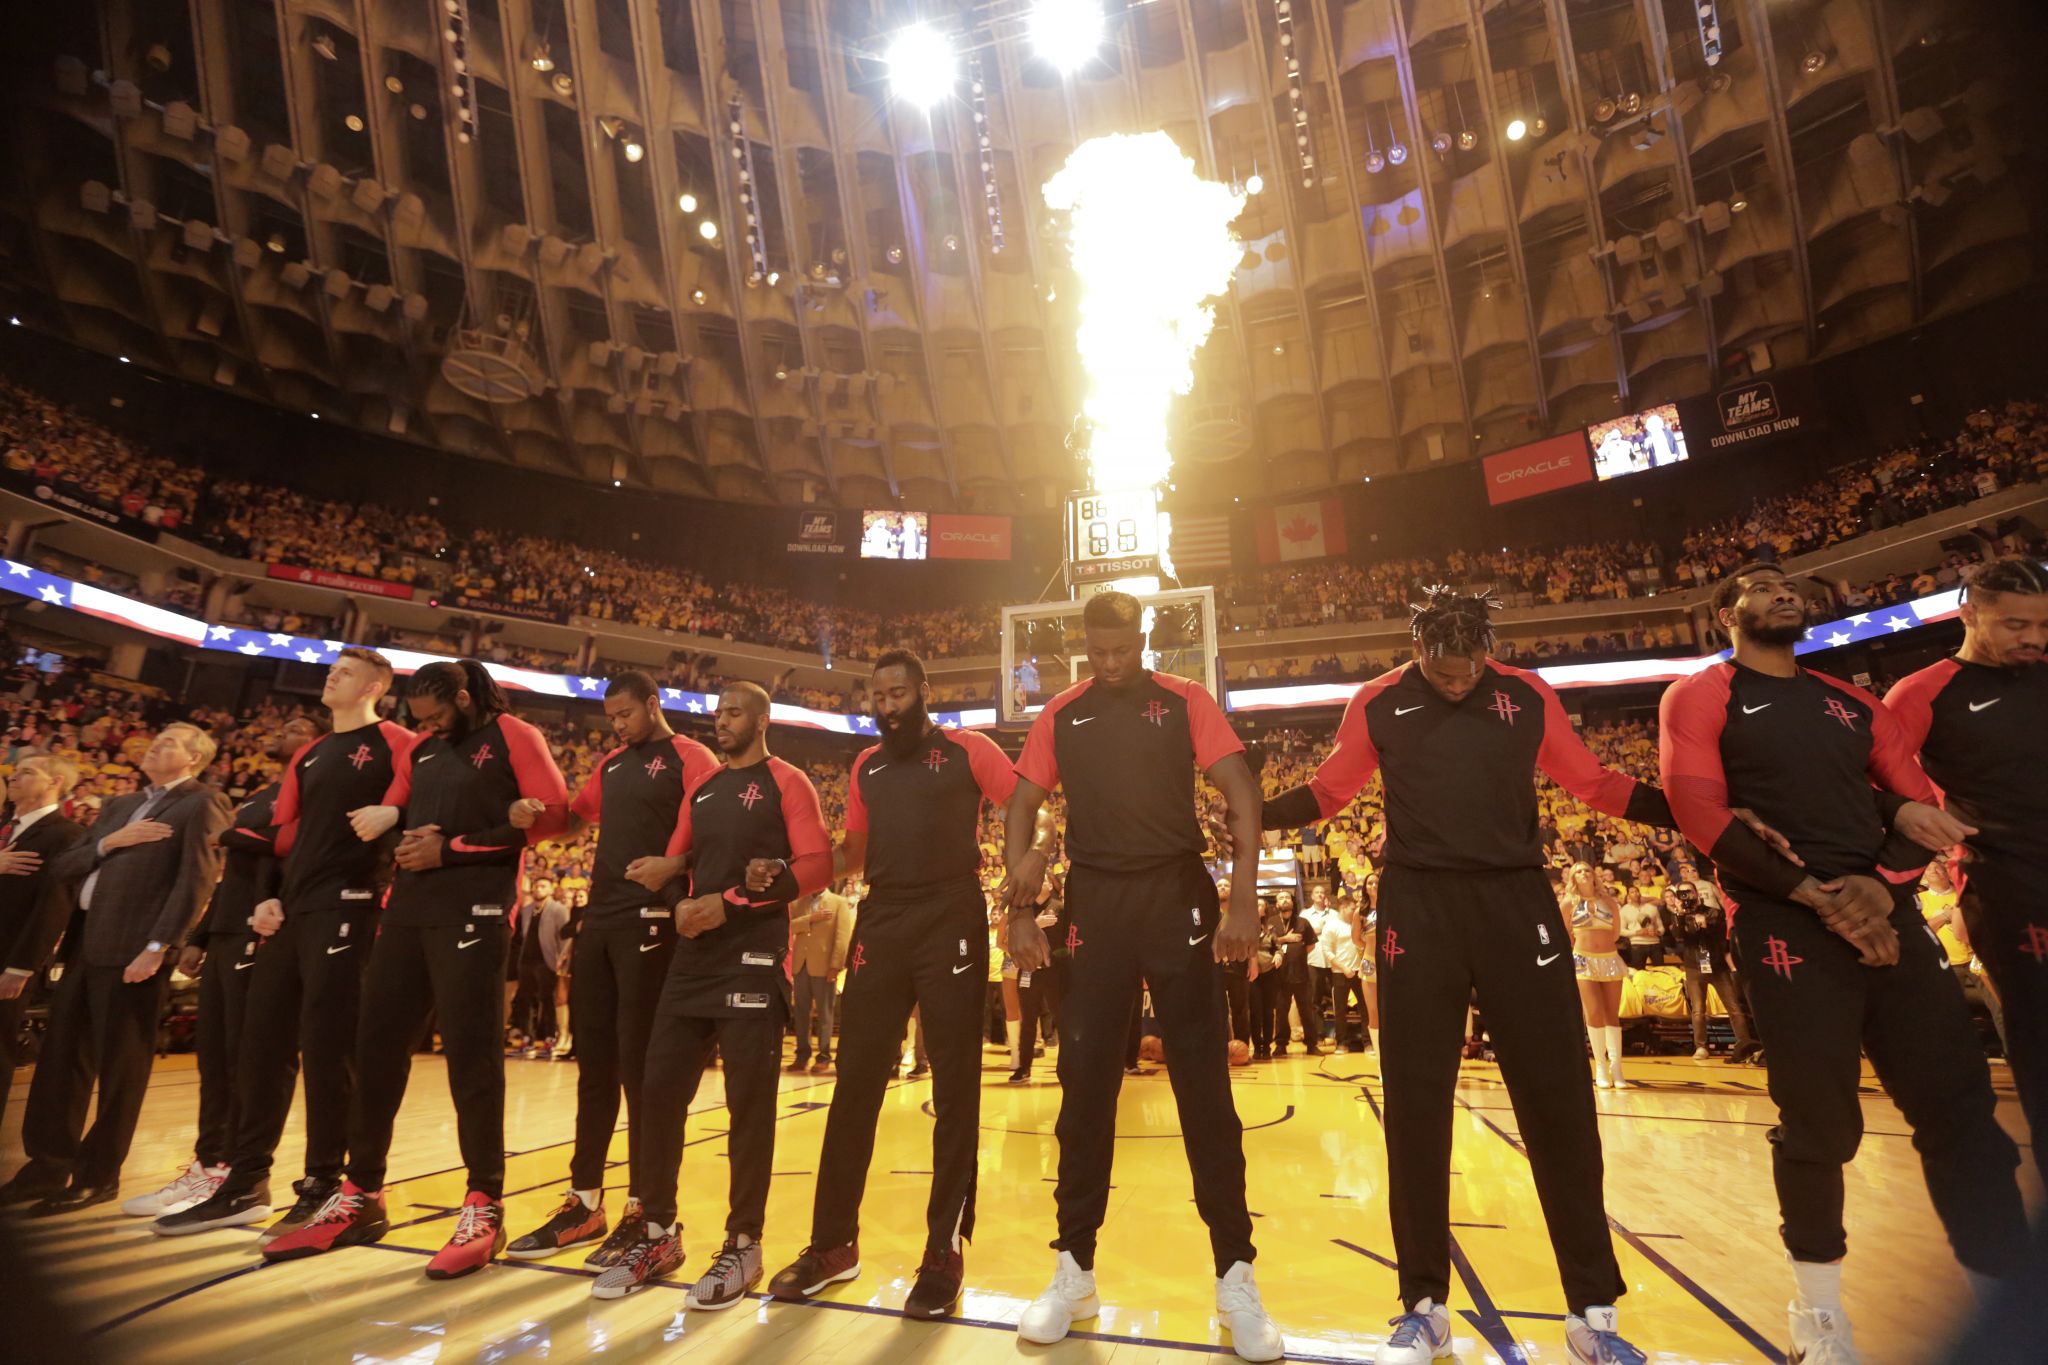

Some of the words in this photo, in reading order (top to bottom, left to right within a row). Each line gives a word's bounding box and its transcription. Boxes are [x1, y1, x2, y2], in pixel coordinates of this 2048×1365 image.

[1738, 391, 1757, 405] MY
[1727, 398, 1770, 418] TEAMS
[1711, 424, 1771, 448] DOWNLOAD
[1773, 416, 1800, 431] NOW
[1496, 456, 1572, 484] ORACLE
[803, 525, 833, 534] TEAMS
[940, 532, 1001, 543] ORACLE
[787, 543, 826, 553] DOWNLOAD
[827, 545, 846, 553] NOW
[1097, 558, 1153, 573] TISSOT
